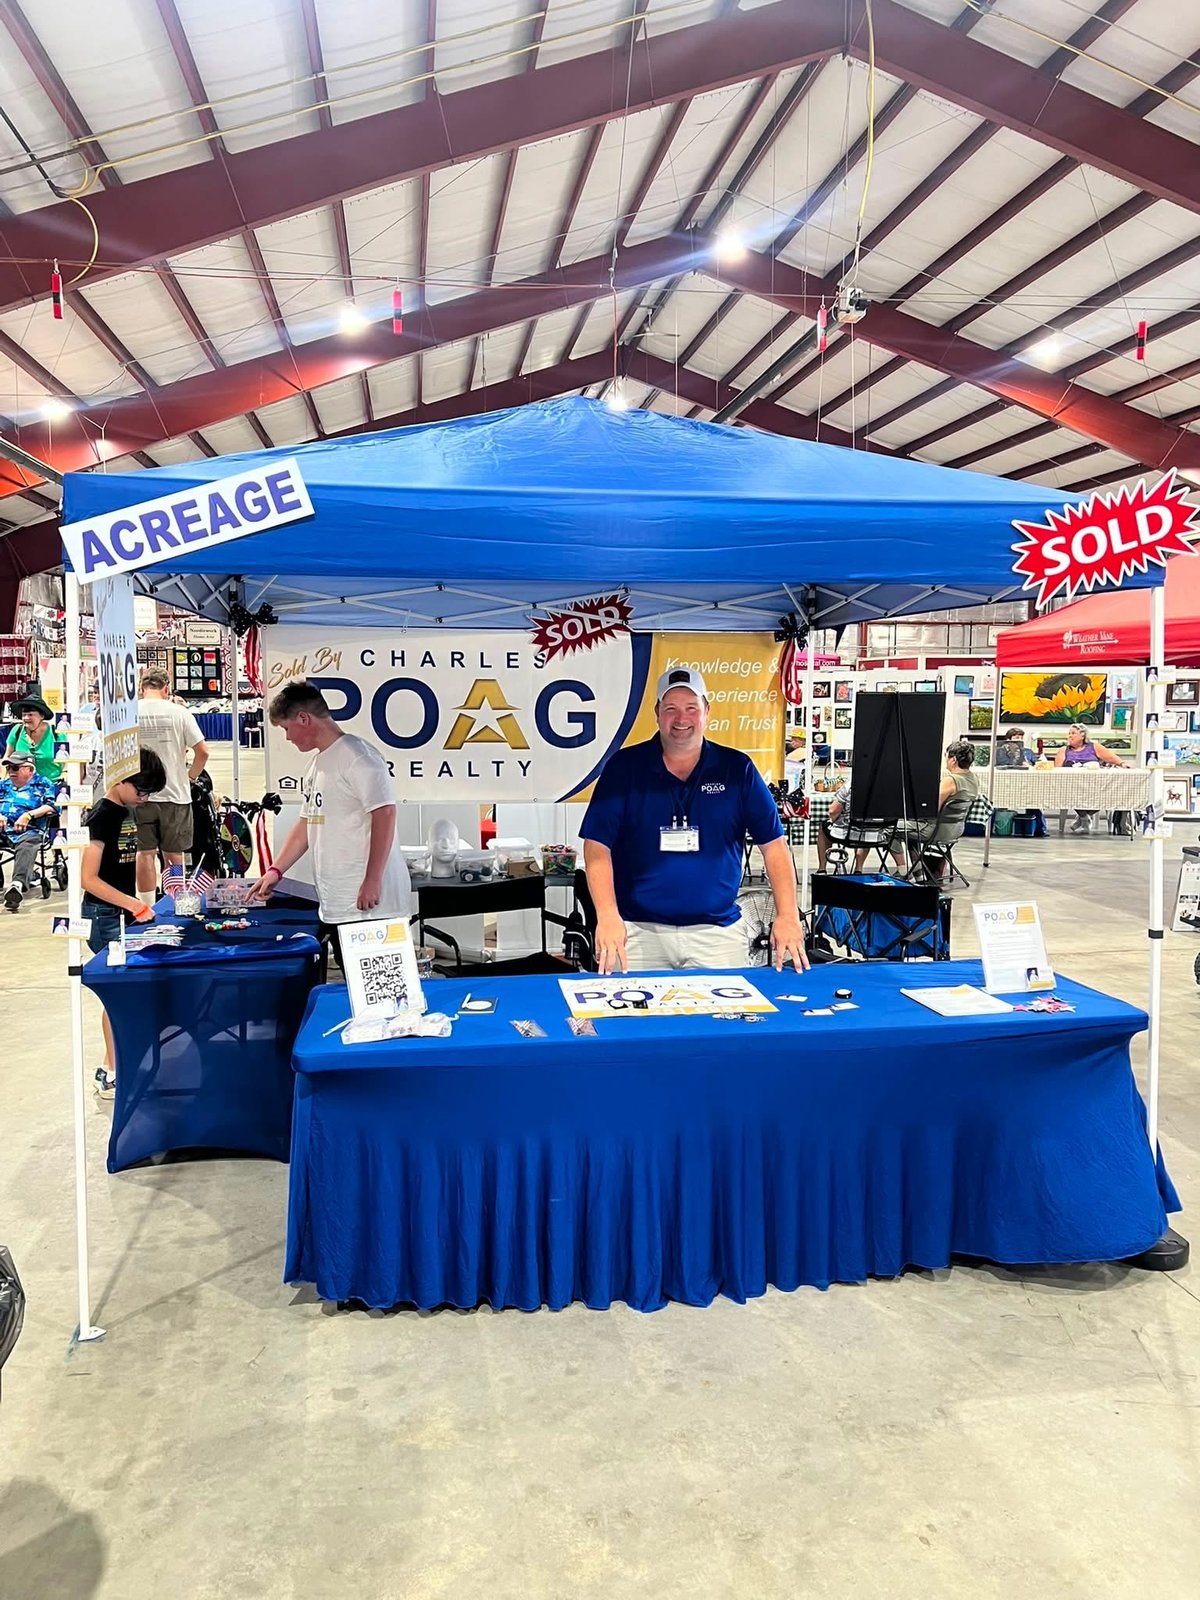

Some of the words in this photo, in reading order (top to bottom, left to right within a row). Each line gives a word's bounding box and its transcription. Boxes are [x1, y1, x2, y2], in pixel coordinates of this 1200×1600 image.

[82, 470, 302, 573] ACREAGE
[1041, 505, 1174, 576] SOLD
[545, 606, 620, 647] SOLD
[103, 632, 126, 649] CHARLES
[359, 648, 546, 669] CHARLES
[768, 657, 779, 673] &
[267, 655, 308, 689] Sold
[311, 646, 343, 674] By
[100, 652, 136, 706] POAG
[705, 688, 779, 703] perience
[109, 707, 127, 725] REALTY
[305, 676, 598, 750] POAG
[704, 718, 730, 732] an
[737, 715, 778, 731] Trust
[701, 784, 726, 792] POAG
[984, 911, 1015, 922] POAG
[351, 930, 384, 943] POAG
[574, 987, 752, 1004] POAG
